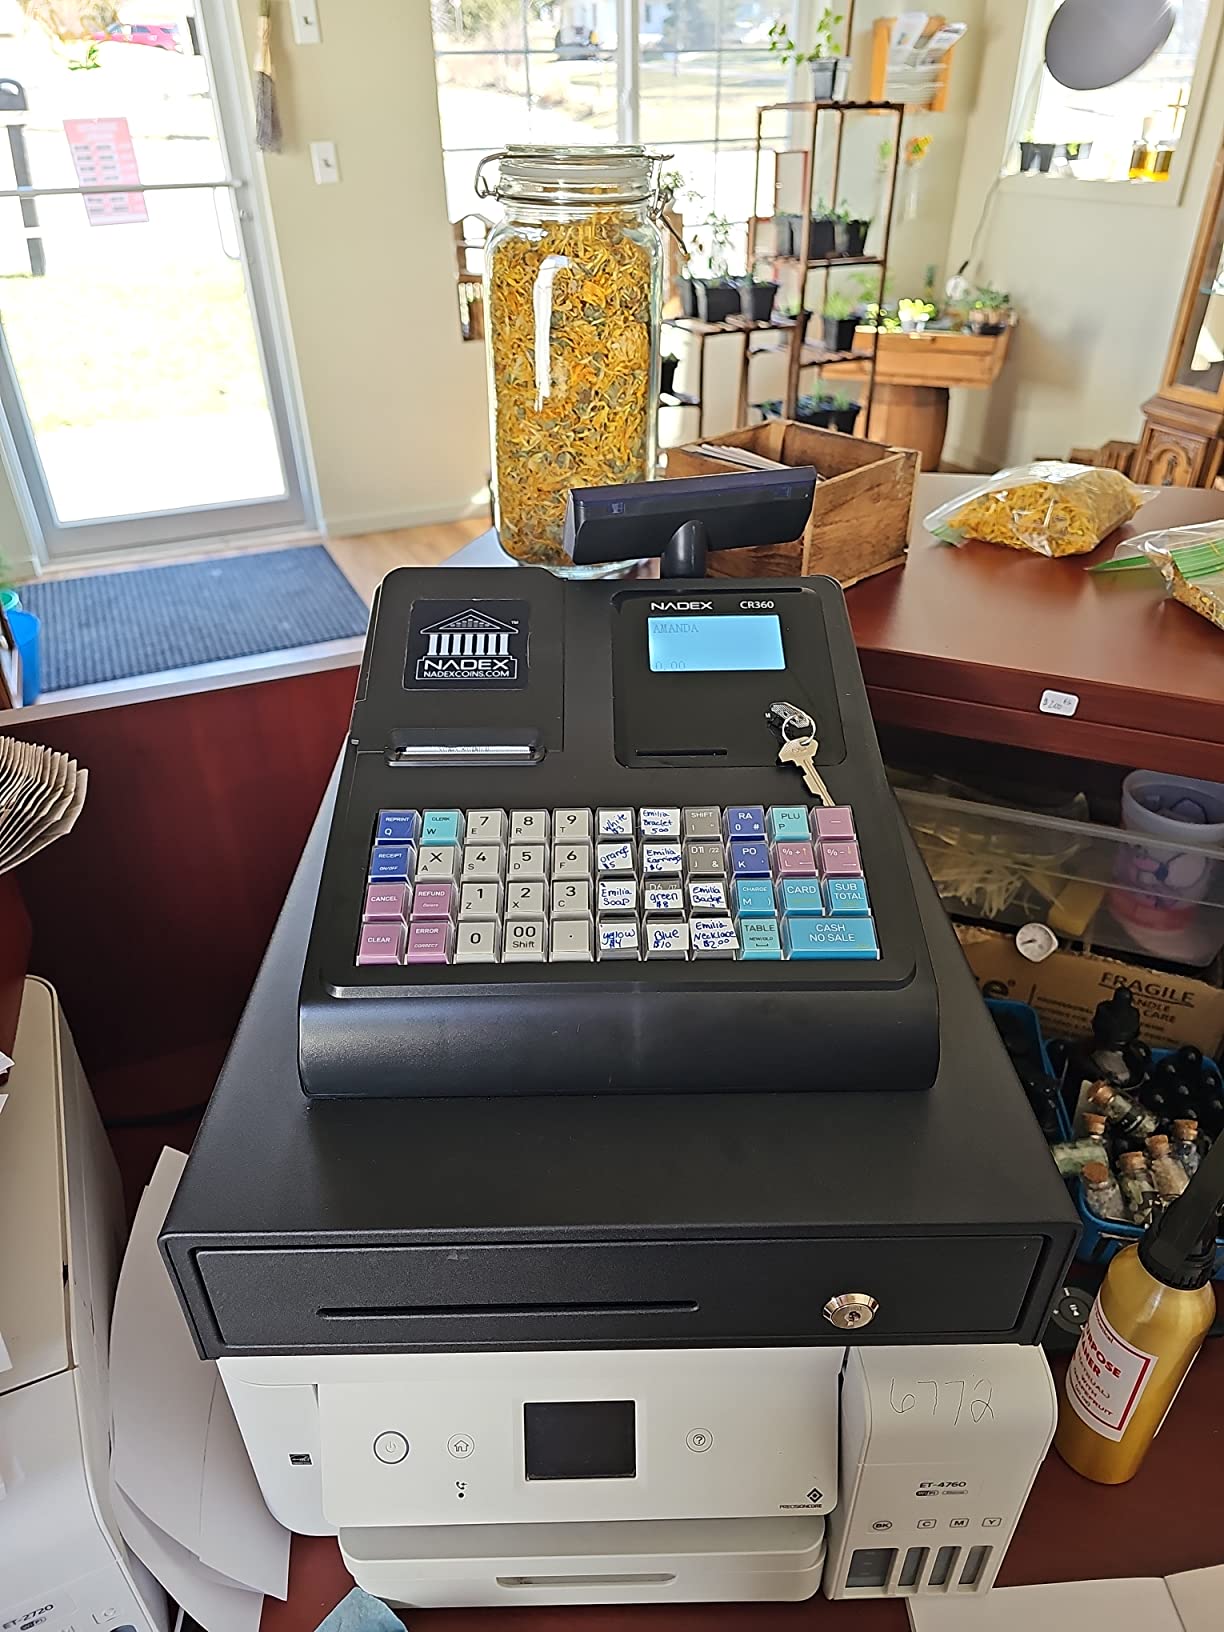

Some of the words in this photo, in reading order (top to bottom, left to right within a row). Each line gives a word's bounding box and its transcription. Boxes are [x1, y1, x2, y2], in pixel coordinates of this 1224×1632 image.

[651, 602, 713, 610] NADEX
[740, 601, 774, 609] CR360
[653, 624, 699, 633] AMANDA
[424, 659, 509, 670] NADEX
[480, 816, 489, 826] 7
[523, 816, 534, 826] 8
[567, 815, 576, 824] 9
[384, 828, 392, 836] Q
[429, 852, 442, 862] X
[476, 852, 486, 861] 4
[522, 852, 532, 861] 5
[567, 851, 577, 860] 6
[646, 848, 676, 856] Emilia
[477, 888, 483, 898] 1
[521, 888, 531, 898] 2
[566, 886, 576, 896] 3
[601, 888, 632, 897] Emilia
[787, 886, 816, 894] CARD
[650, 893, 678, 903] green
[696, 921, 727, 929] Emilia
[513, 926, 536, 938] 00
[654, 929, 679, 941] Blue
[470, 933, 481, 944] 0
[1101, 972, 1195, 1003] FRAGILE
[1144, 1008, 1176, 1024] CARE
[890, 1378, 994, 1426] 6772
[2, 1604, 54, 1630] ET-2720
